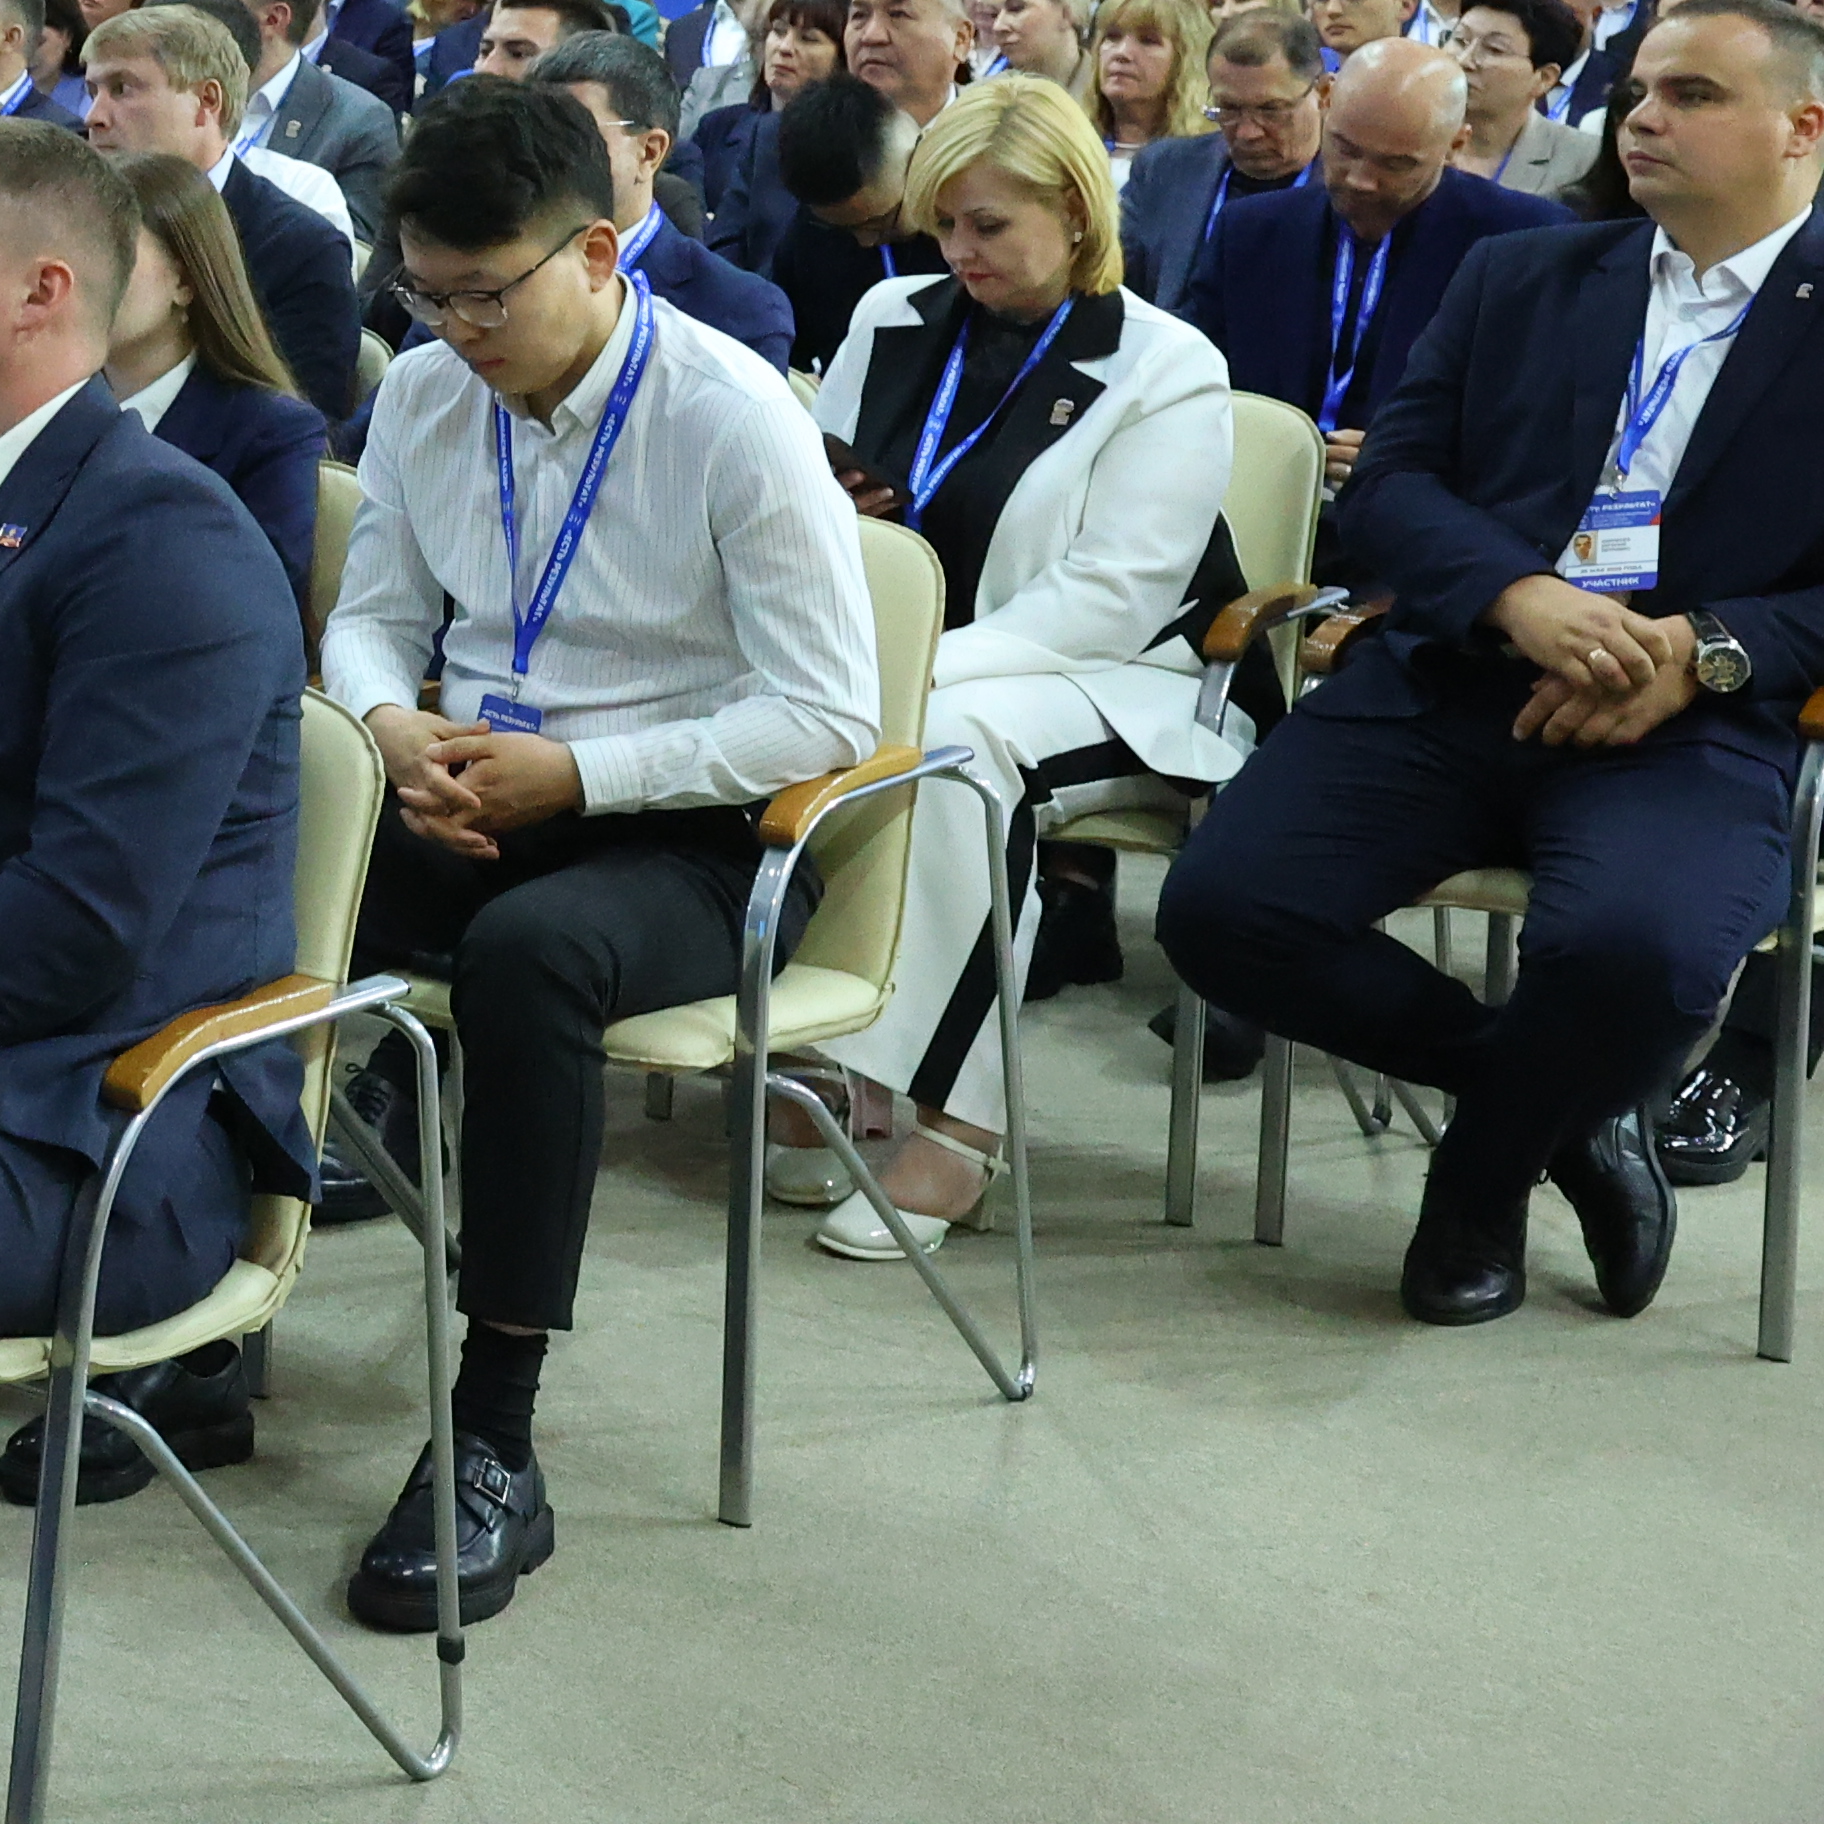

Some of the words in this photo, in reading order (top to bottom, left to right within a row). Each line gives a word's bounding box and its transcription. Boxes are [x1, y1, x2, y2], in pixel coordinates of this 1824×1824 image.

[622, 326, 650, 388] РЕЗУЛЬТАТ»
[600, 412, 616, 445] «ЕСТЬ
[577, 445, 606, 509] РЕЗУЛЬТАТ»
[556, 528, 574, 562] «ЕСТЬ
[1581, 576, 1640, 588] УЧАСТНИК
